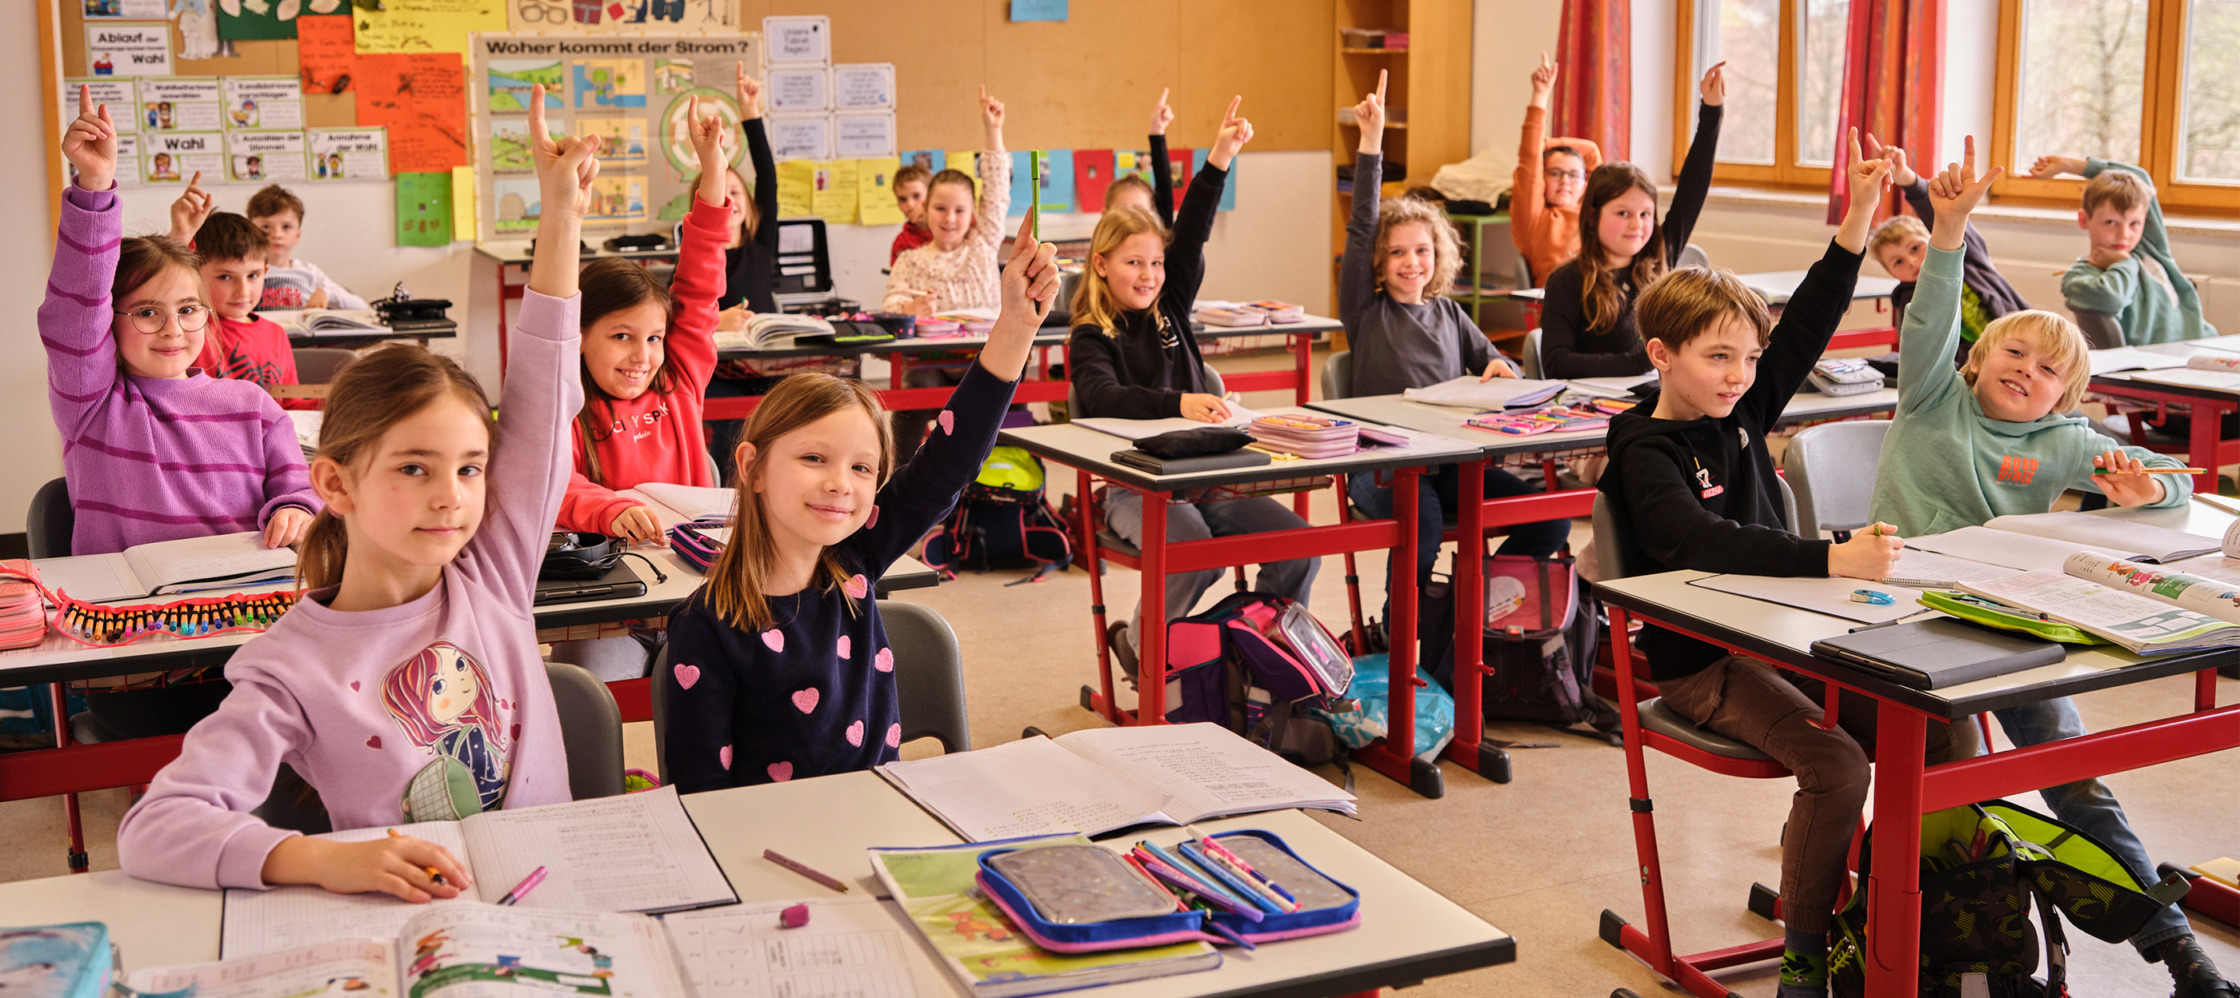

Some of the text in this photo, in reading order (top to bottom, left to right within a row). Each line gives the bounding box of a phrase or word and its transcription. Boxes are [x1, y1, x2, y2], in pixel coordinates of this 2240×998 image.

[97, 32, 143, 43] Ablauf
[486, 41, 555, 54] Woher
[559, 41, 633, 54] kommt
[638, 41, 671, 54] der
[675, 41, 735, 54] Strom
[131, 54, 165, 64] Wahl
[164, 137, 205, 150] Wahl
[355, 143, 378, 151] Wahl
[611, 415, 639, 433] CITY
[2000, 455, 2039, 472] GOOD
[1996, 471, 2035, 484] VIBES
